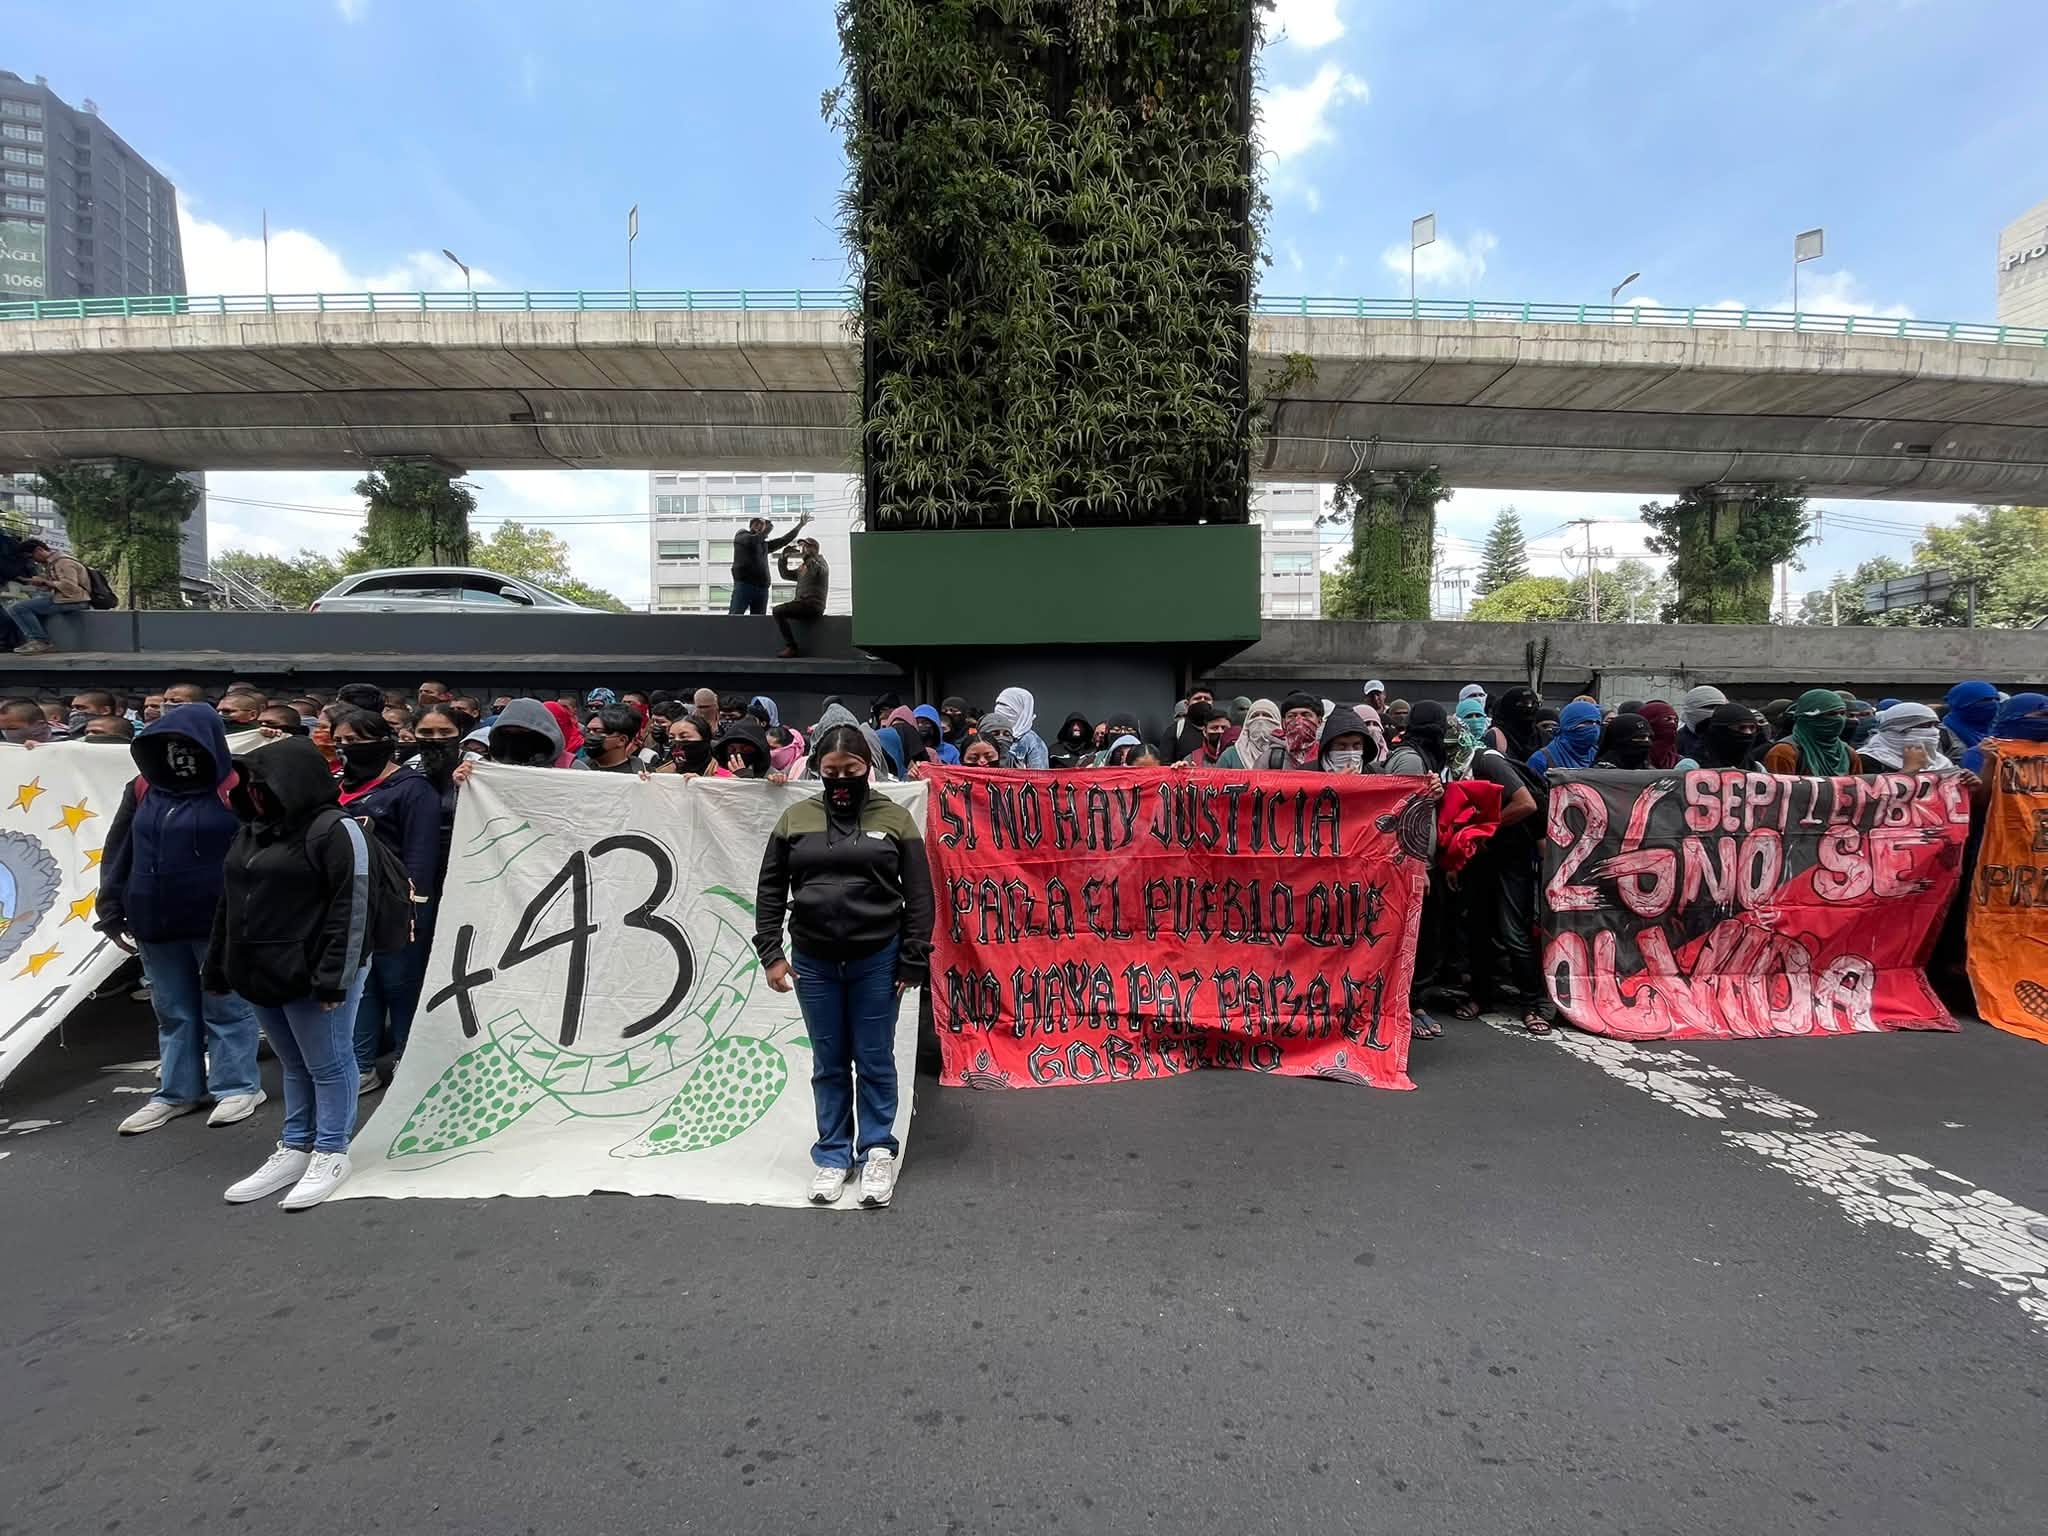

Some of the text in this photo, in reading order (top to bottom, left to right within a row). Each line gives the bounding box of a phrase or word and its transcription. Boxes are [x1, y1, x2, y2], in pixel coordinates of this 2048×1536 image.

[2, 273, 43, 288] 1066
[938, 778, 1342, 857] SI NO HAY JUSTICIA
[1544, 768, 1970, 918] 26 SEPTIEMBRE
[1676, 824, 1946, 914] NO SE
[946, 873, 1391, 949] PARA EL PUEBLO QUE
[945, 959, 1393, 1051] NO HAYA PAZ PARA EL
[1027, 1033, 1284, 1086] GOBIERNO
